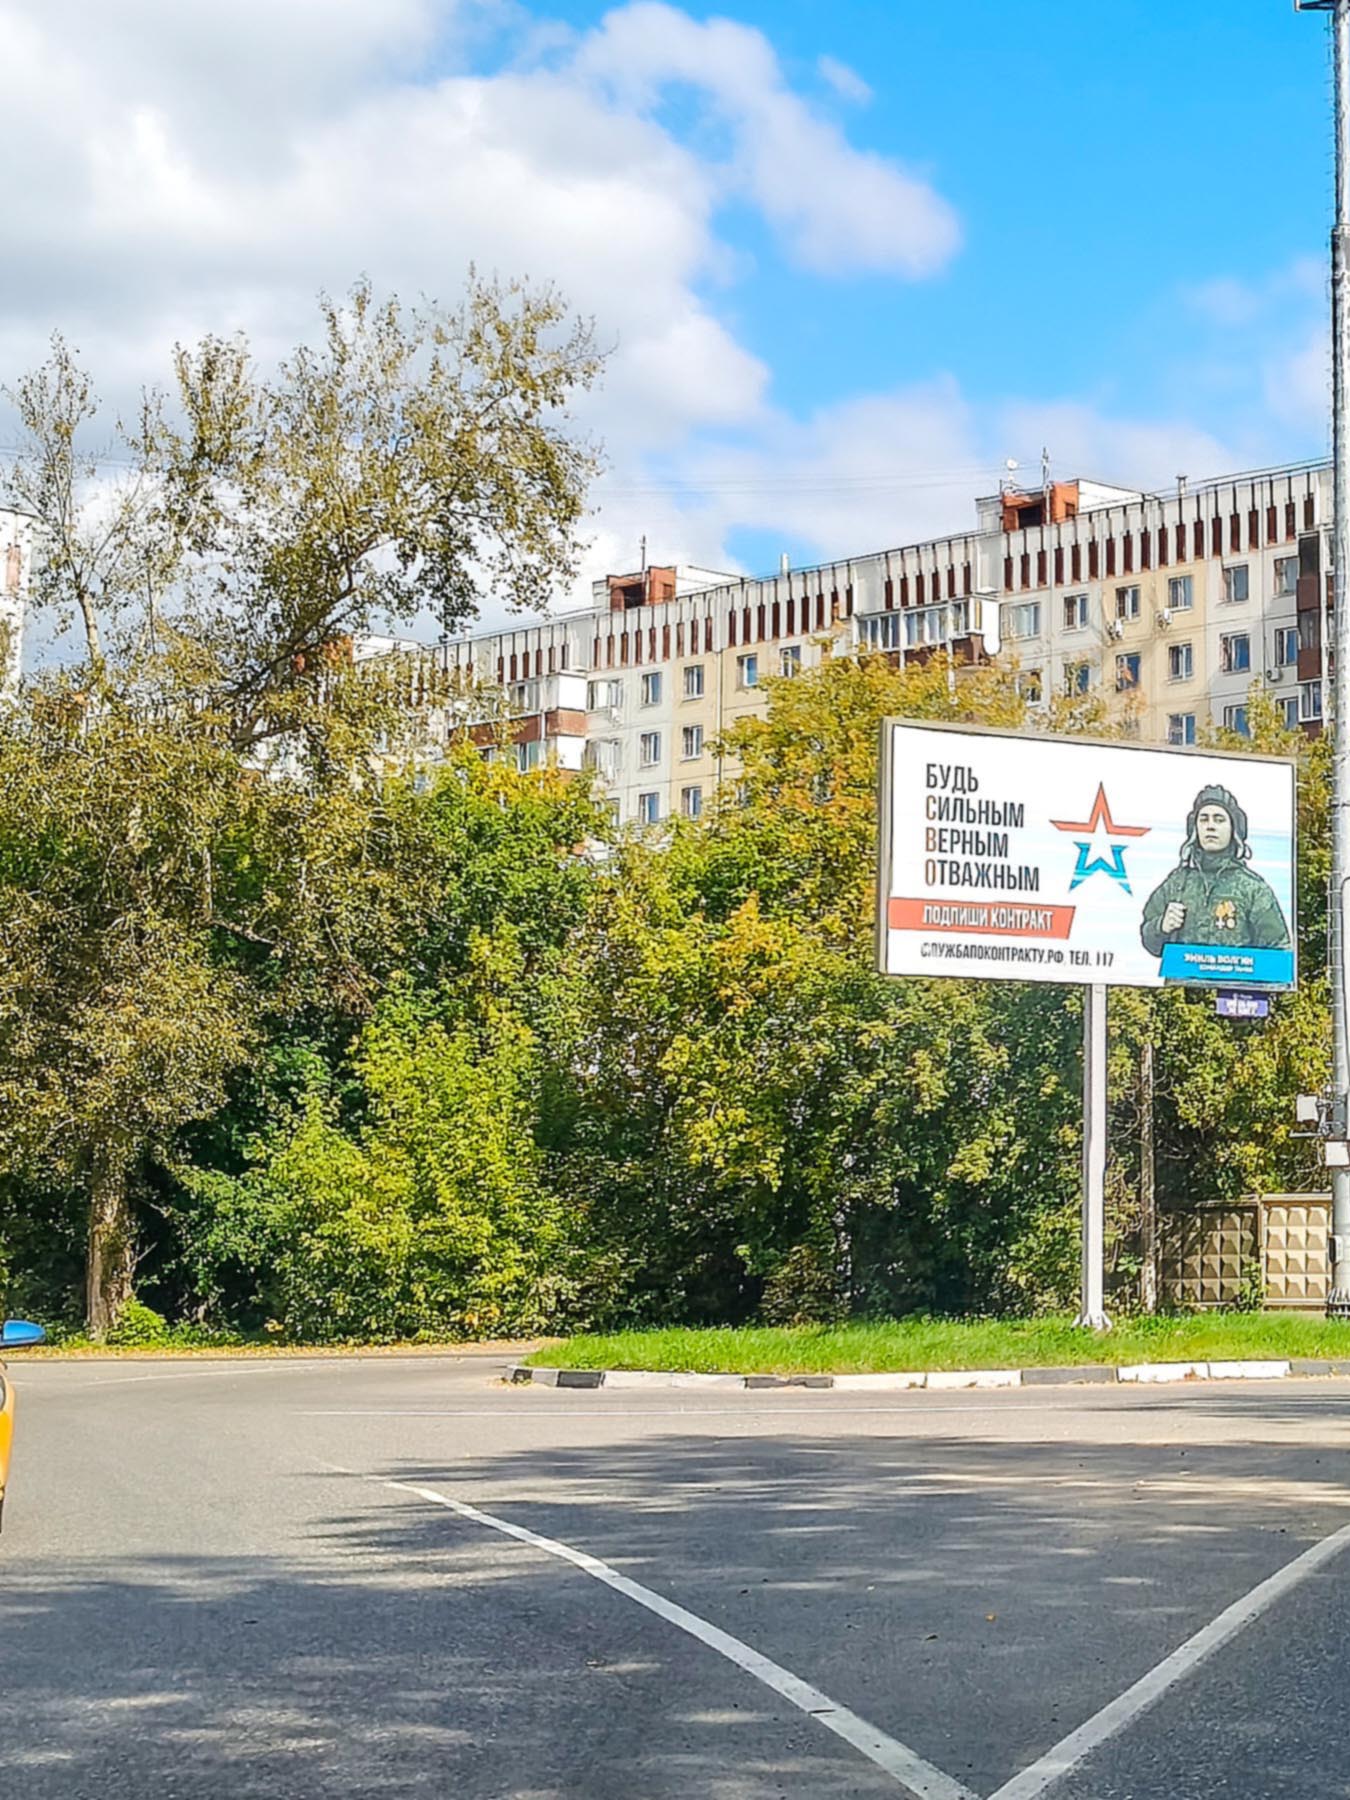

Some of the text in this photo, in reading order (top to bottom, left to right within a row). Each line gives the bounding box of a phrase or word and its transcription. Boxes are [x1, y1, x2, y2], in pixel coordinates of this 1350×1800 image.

[926, 763, 979, 794] БУДЬ
[925, 794, 1024, 828] СИЛЬНЫМ
[925, 827, 1008, 858] ВЕРНЫМ
[925, 858, 1040, 892] ОТВАЖНЫМ
[922, 904, 1054, 931] ПОДПИШИ КОНТРАКТ
[1069, 949, 1093, 967] ТЕЛ.
[1096, 951, 1114, 967] 117
